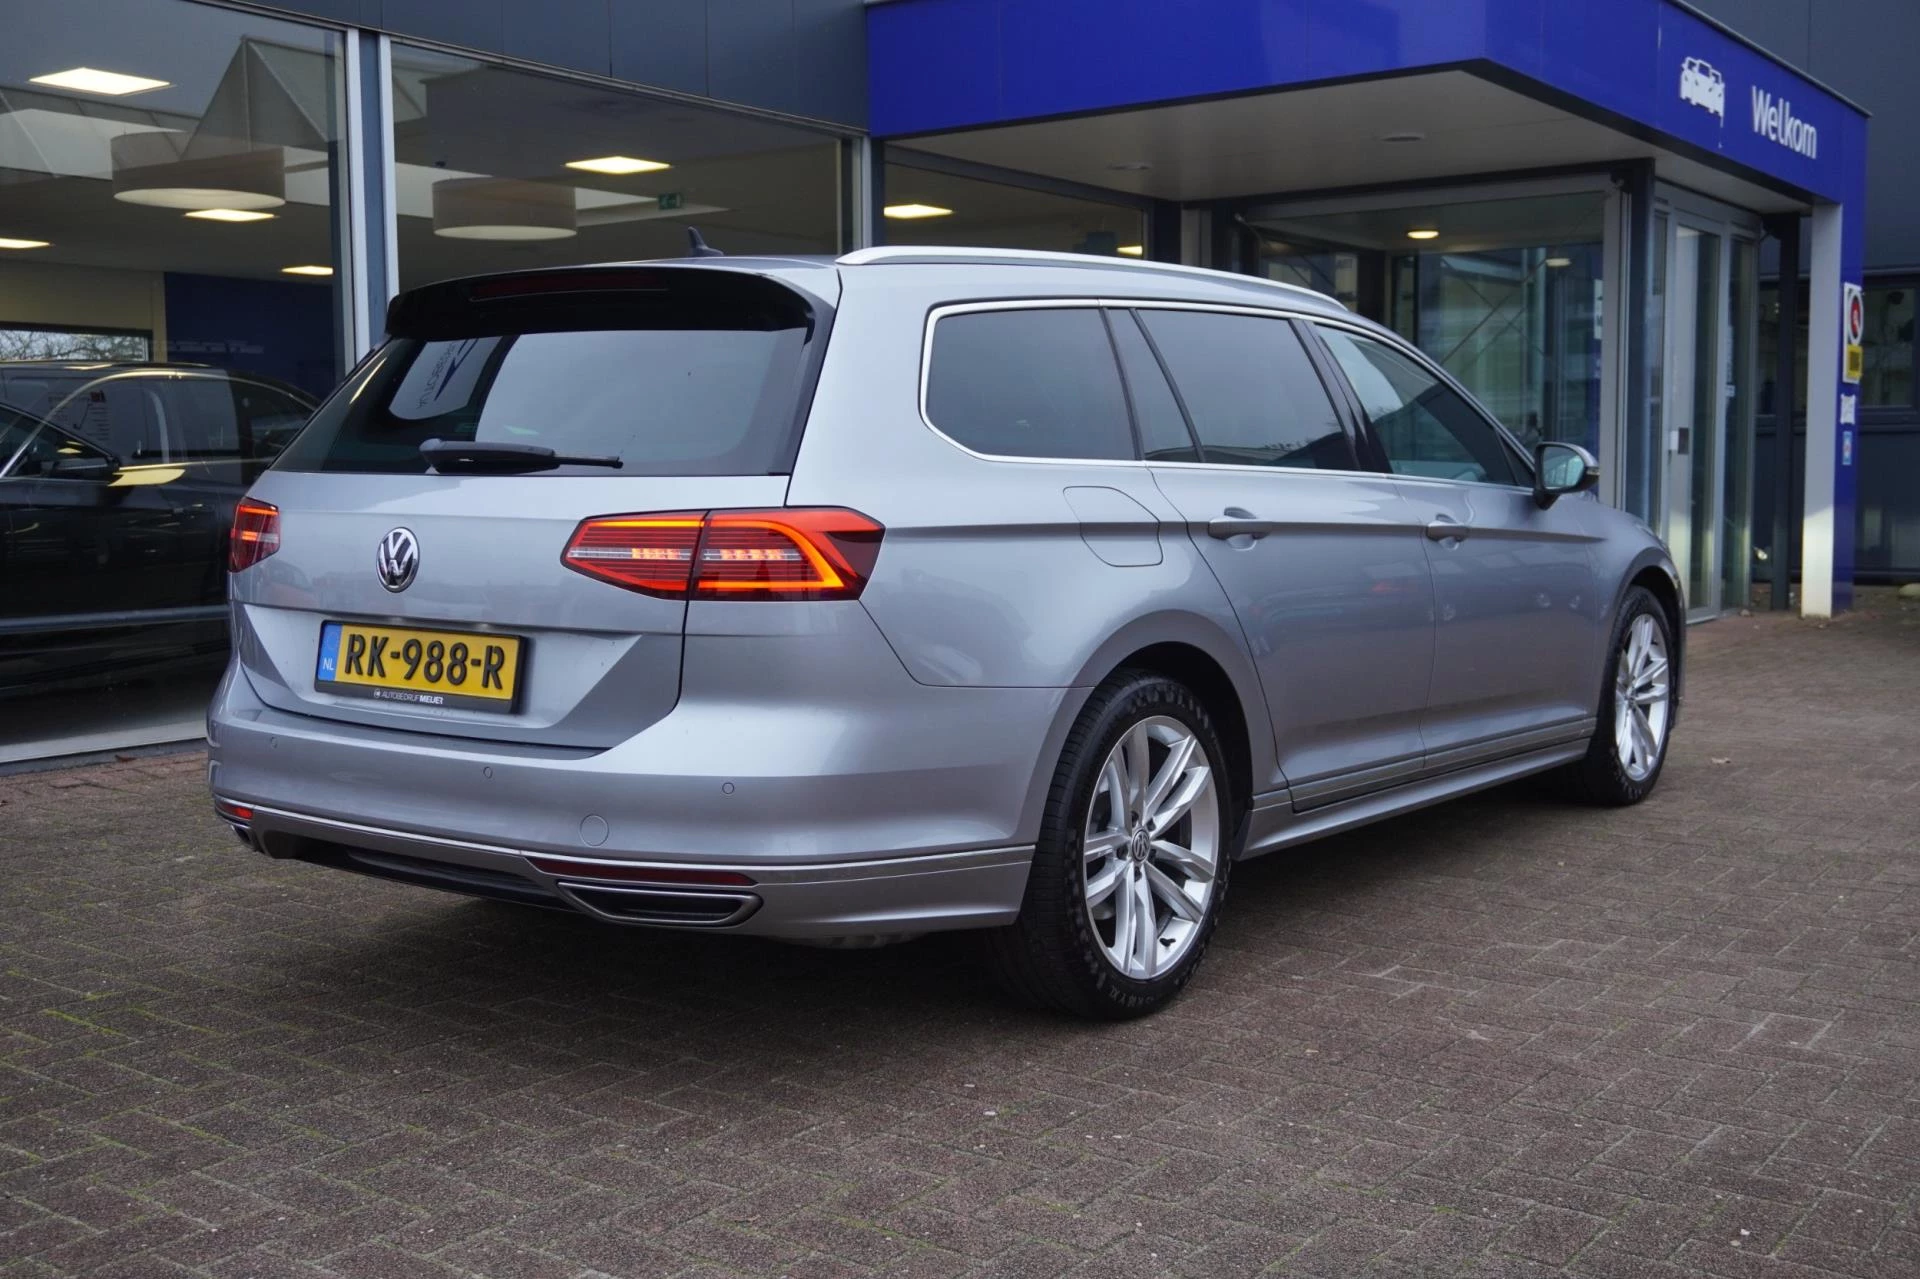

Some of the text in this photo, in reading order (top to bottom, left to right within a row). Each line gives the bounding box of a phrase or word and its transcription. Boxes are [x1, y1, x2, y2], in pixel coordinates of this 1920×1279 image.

[1752, 85, 1817, 160] Welkom
[322, 658, 335, 672] NL
[344, 633, 505, 690] RK-988-R
